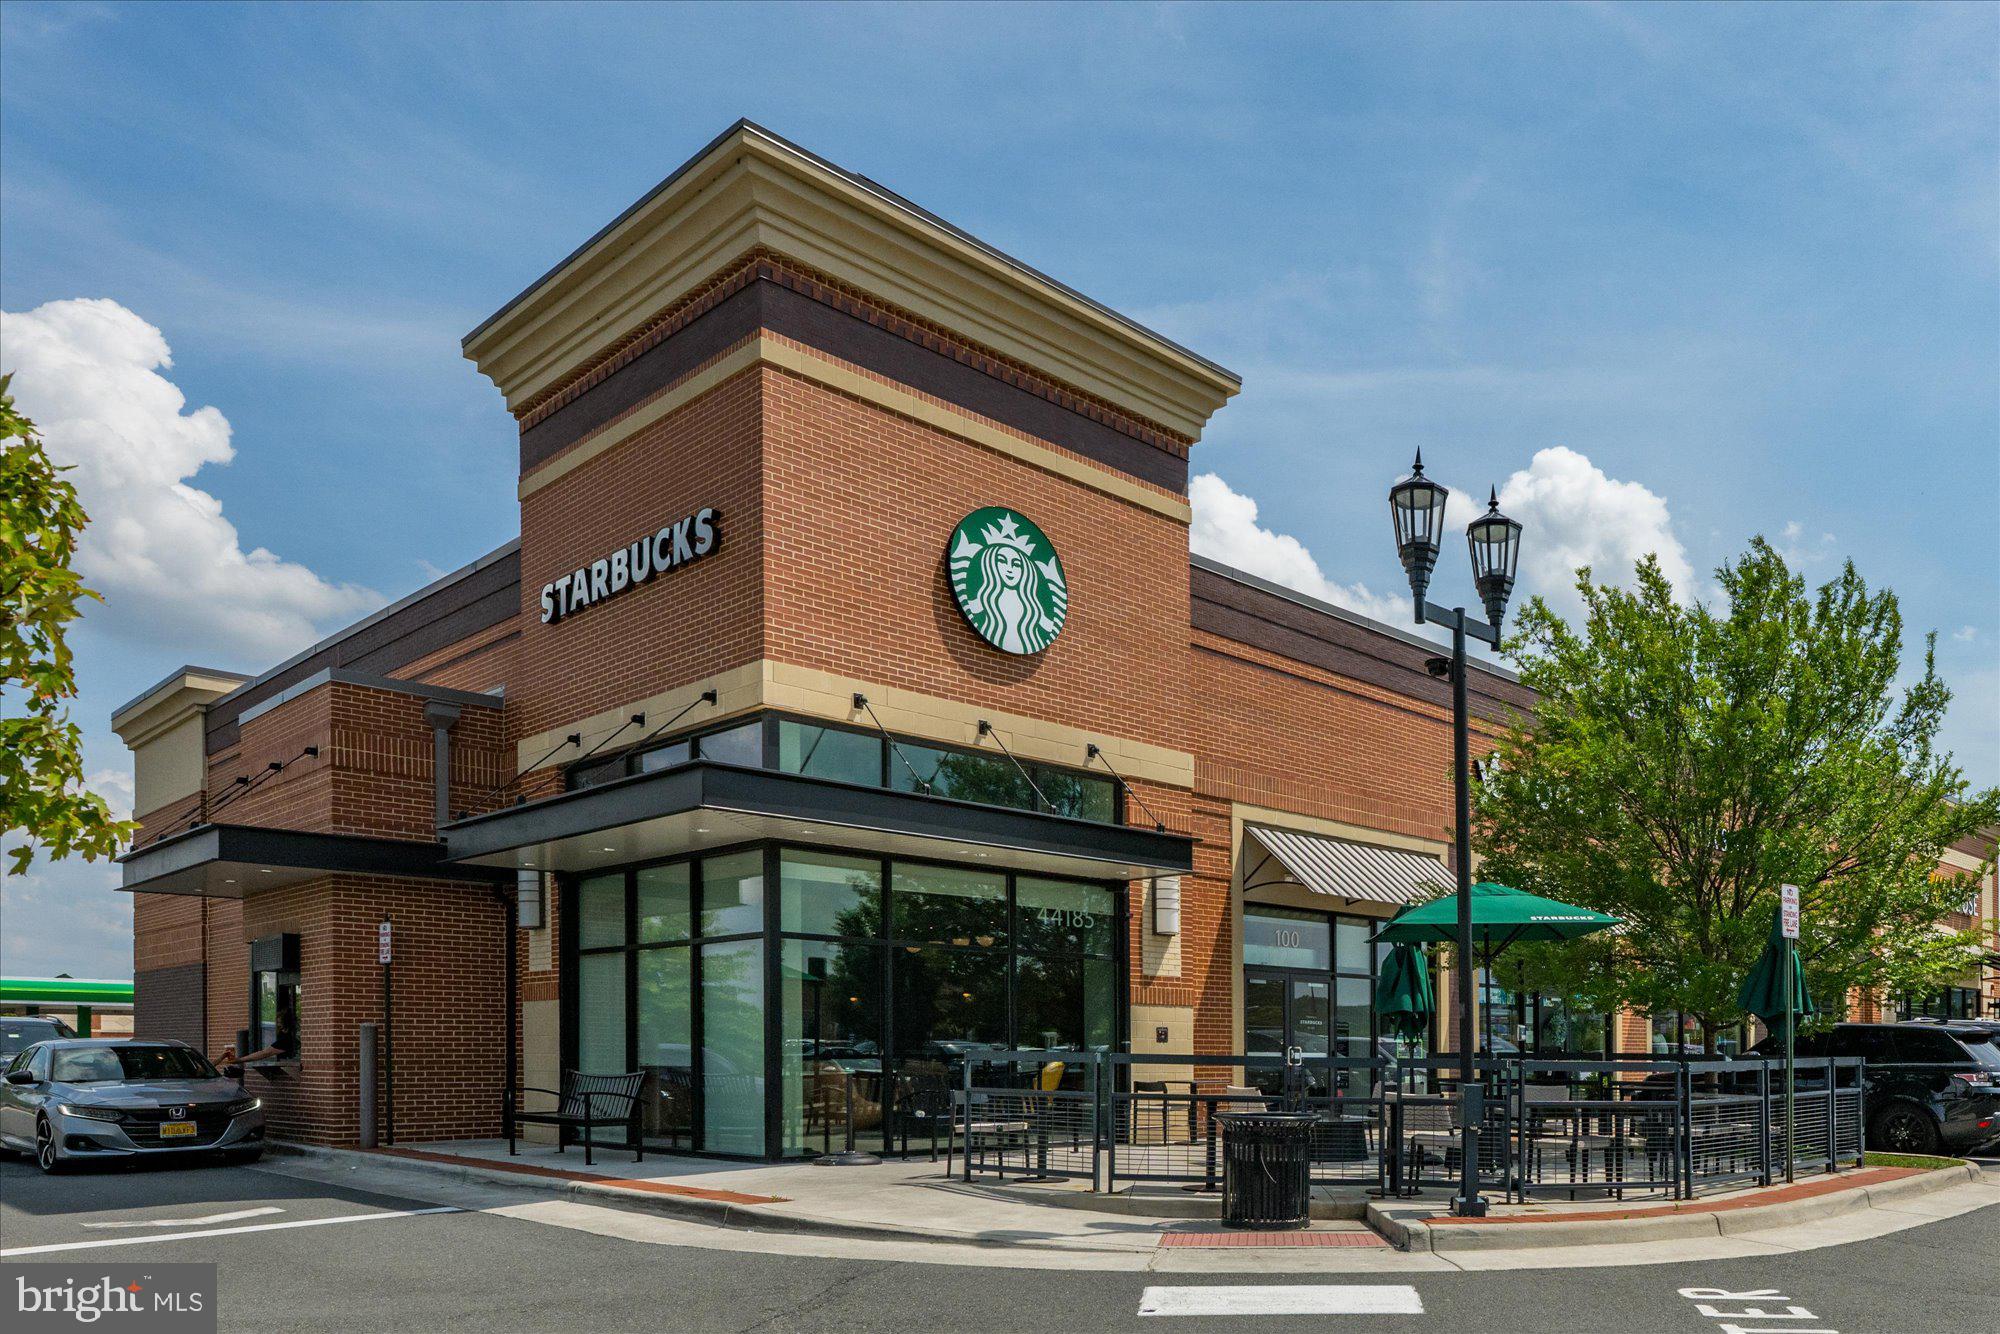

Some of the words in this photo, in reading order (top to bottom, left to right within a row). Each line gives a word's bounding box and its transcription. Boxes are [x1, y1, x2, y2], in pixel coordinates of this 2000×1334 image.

[540, 508, 718, 624] STARBUCKS
[1037, 907, 1095, 929] 44185
[1275, 929, 1300, 948] 100
